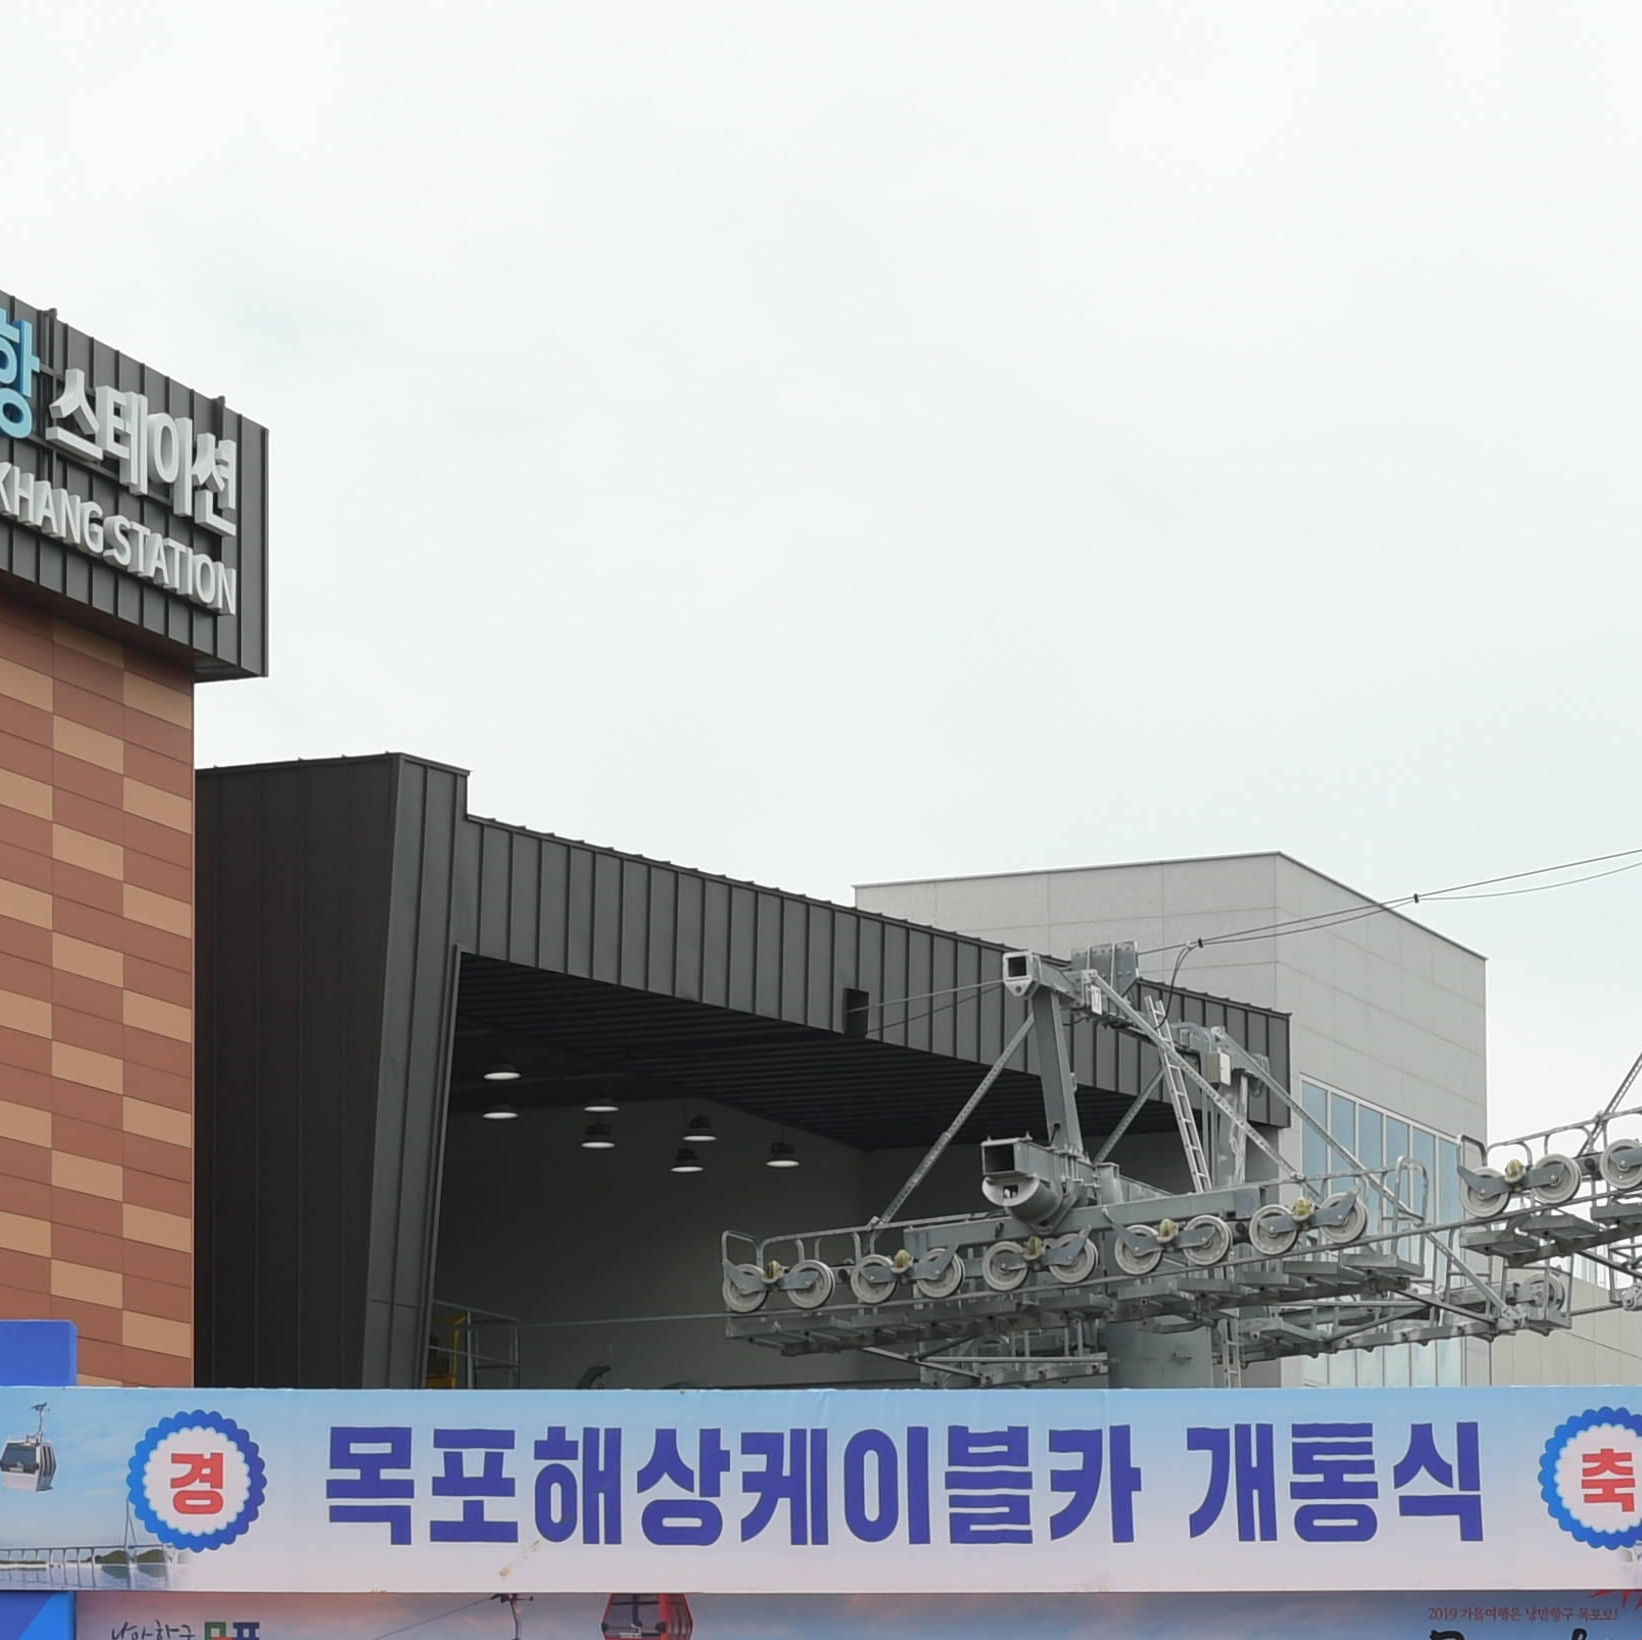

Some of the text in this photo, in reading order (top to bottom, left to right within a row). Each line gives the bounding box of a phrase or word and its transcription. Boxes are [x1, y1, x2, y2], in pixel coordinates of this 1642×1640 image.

[46, 369, 236, 537] 스테이션
[103, 515, 236, 615] STATION
[169, 1419, 1639, 1548] 경 목포해상케이블카 개통식 축
[1428, 1607, 1457, 1621] 2019
